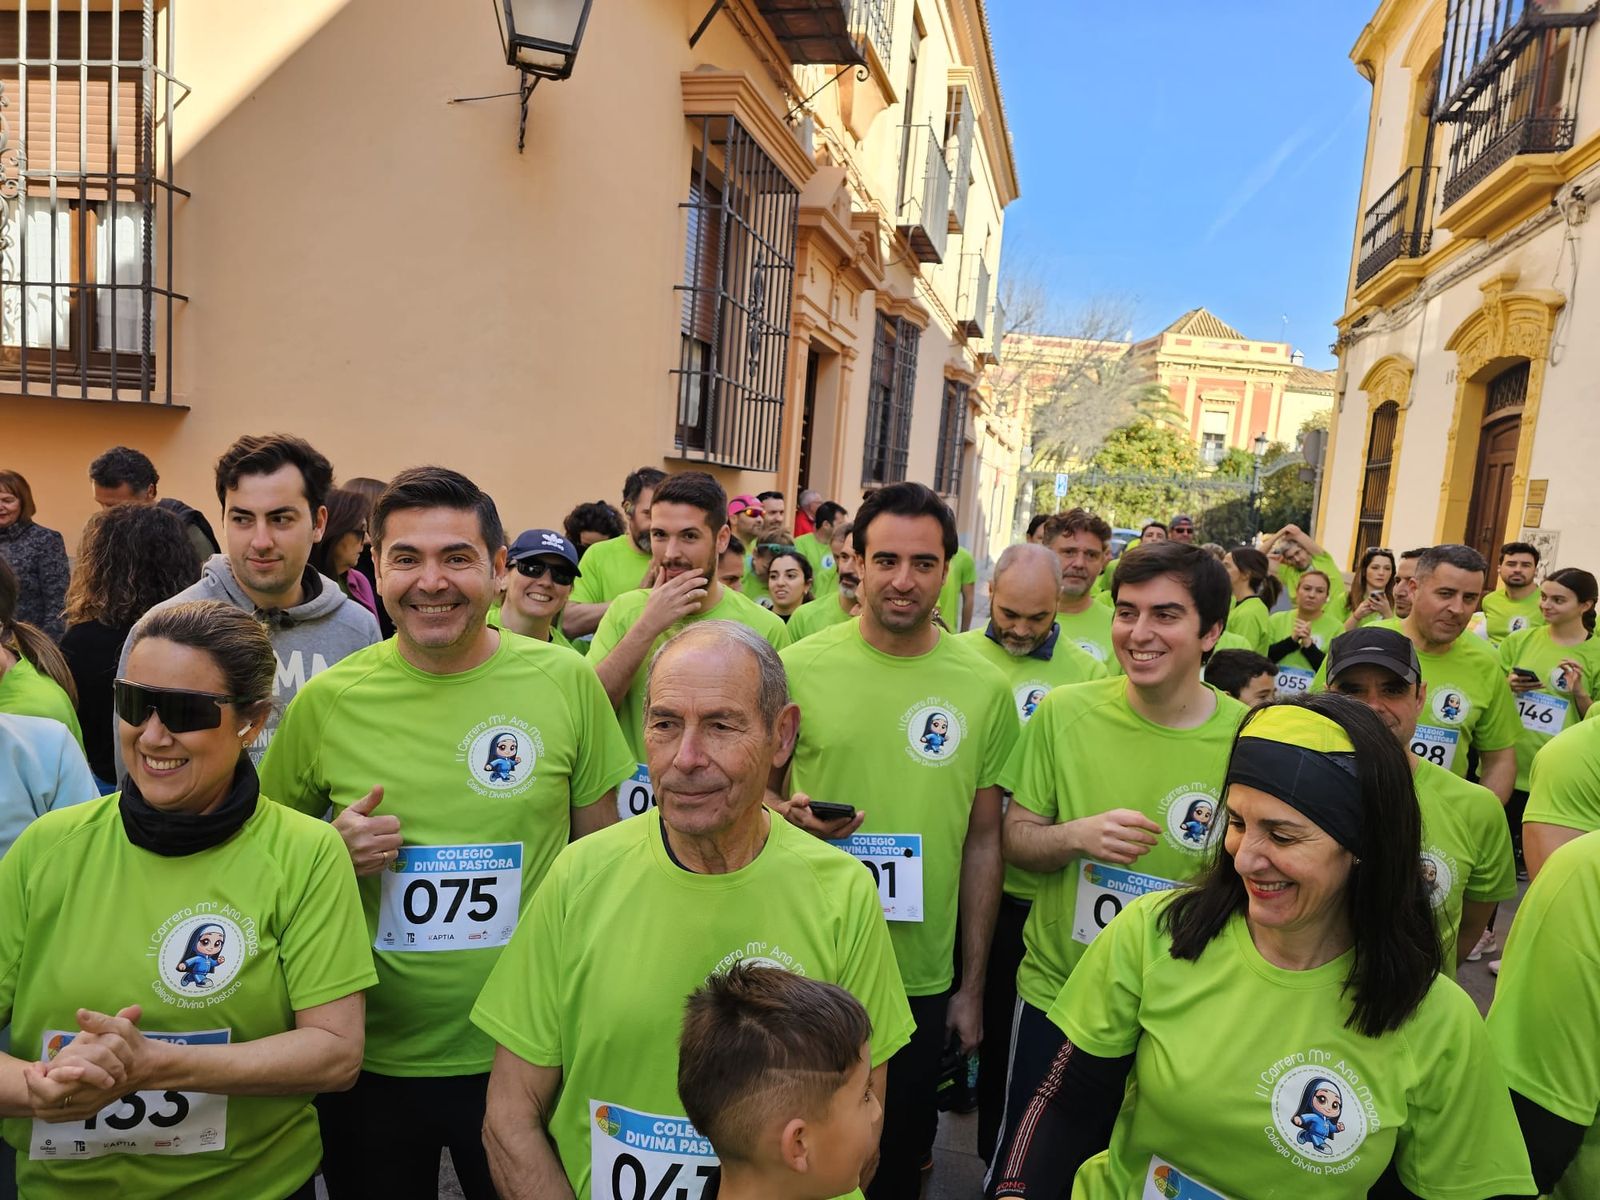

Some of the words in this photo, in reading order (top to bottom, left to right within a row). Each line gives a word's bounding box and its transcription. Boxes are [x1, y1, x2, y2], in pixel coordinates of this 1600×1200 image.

[1278, 674, 1307, 690] 055
[1519, 702, 1553, 723] 146
[458, 722, 487, 752] Carrera
[509, 716, 528, 730] Ana
[852, 837, 896, 846] COLEGIO
[436, 848, 494, 860] COLEGIO
[414, 860, 456, 872] DIVINA
[460, 858, 514, 870] PASTORA
[1107, 880, 1142, 895] DIVINA
[1128, 876, 1174, 890] COLEGIO
[403, 876, 498, 924] 075
[152, 908, 192, 944] Carrera
[220, 904, 240, 920] Ana
[240, 916, 258, 956] Mogas
[770, 946, 792, 966] Ana
[152, 980, 176, 1005] Colegio
[176, 998, 204, 1009] Divina
[206, 981, 242, 1007] Pastora
[1260, 1052, 1304, 1084] Carrera
[1334, 1060, 1359, 1086] Ana
[1358, 1086, 1380, 1133] Mogas
[626, 1130, 676, 1152] DIVINA
[1264, 1126, 1290, 1158] Colegio
[1292, 1156, 1322, 1174] Divina
[1325, 1155, 1360, 1176] Pastora
